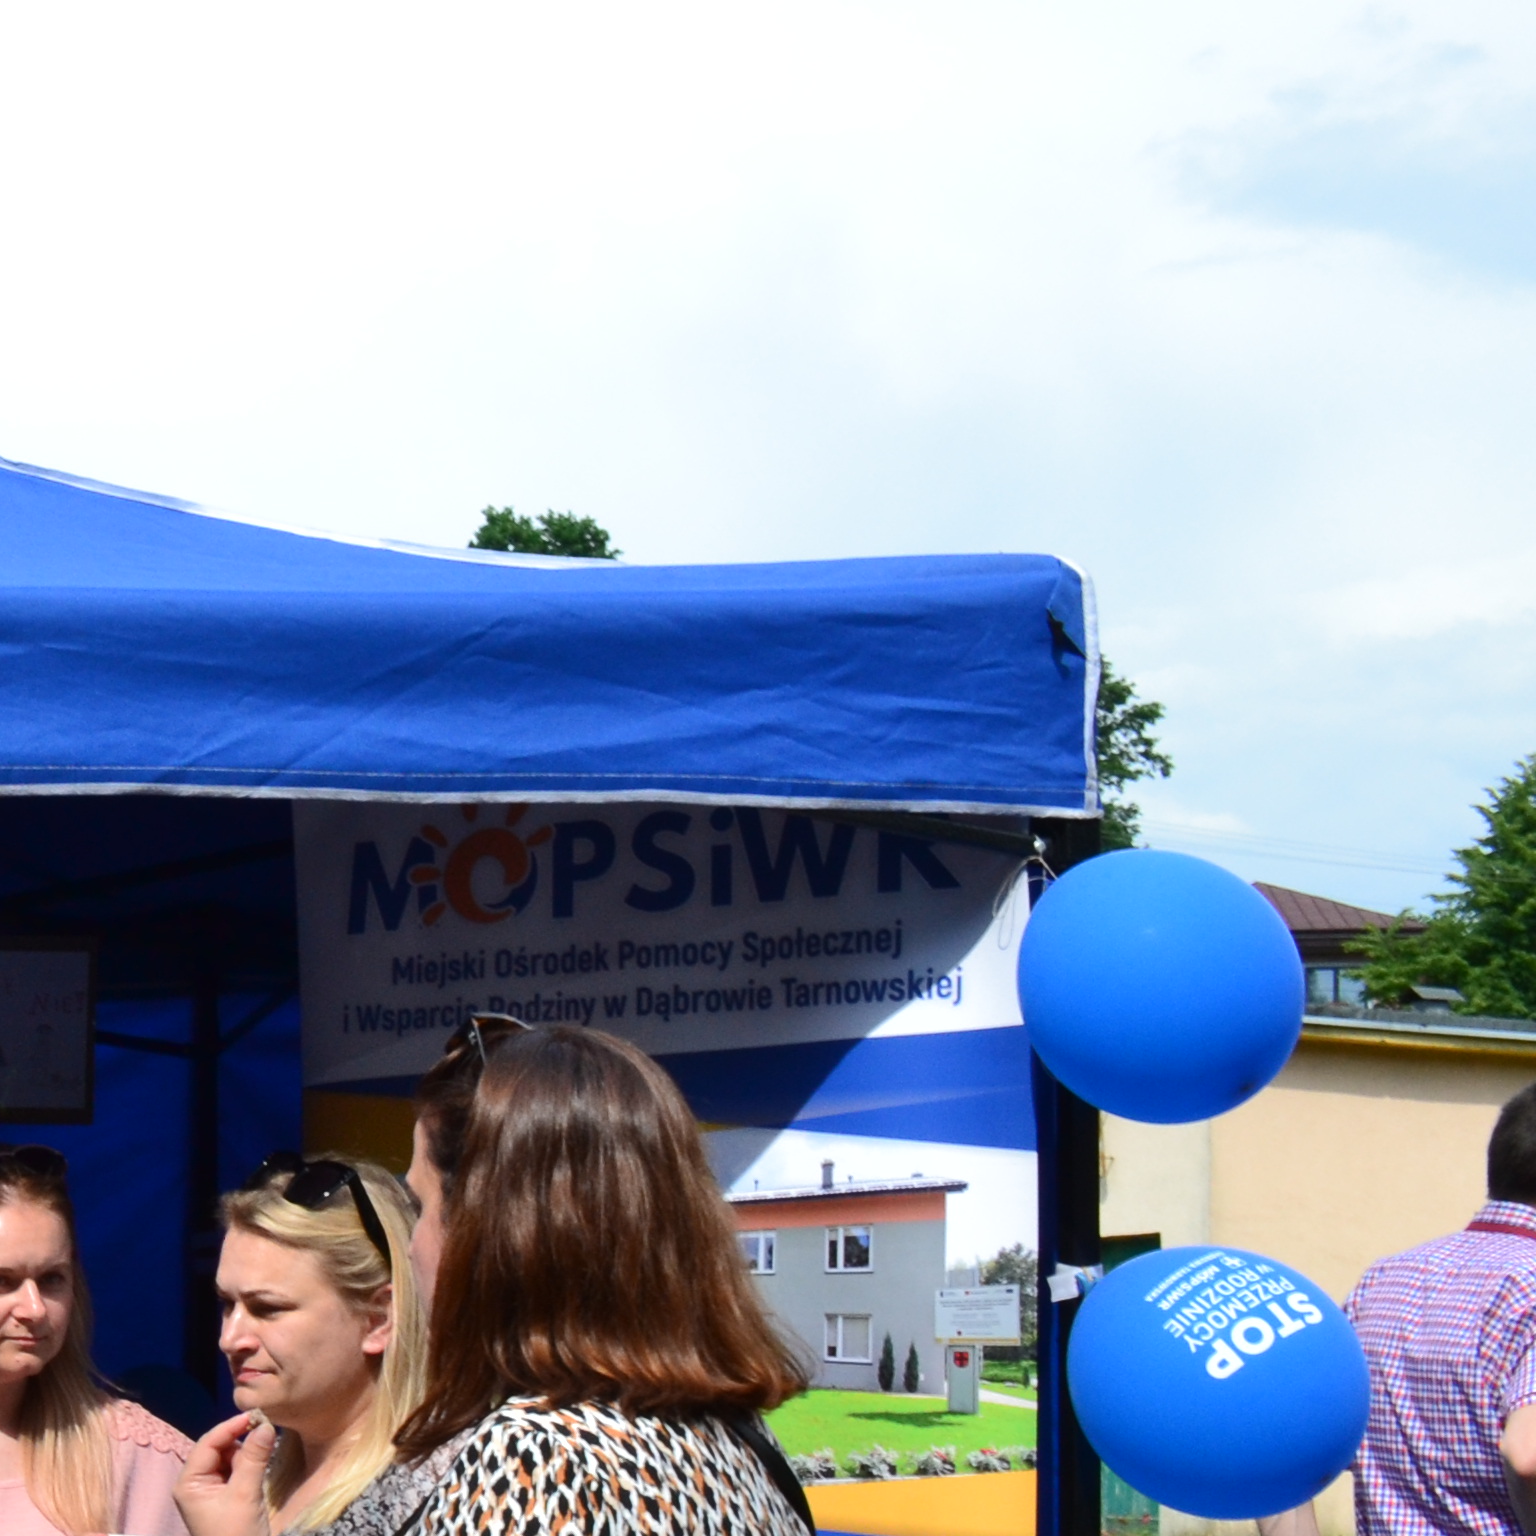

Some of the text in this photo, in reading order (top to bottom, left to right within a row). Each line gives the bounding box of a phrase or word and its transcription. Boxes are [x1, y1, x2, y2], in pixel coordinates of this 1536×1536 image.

[392, 919, 904, 988] Miejski Ośrodek Pomocy Społecznej
[603, 999, 627, 1018] w
[636, 979, 772, 1022] Dąbrowie
[781, 967, 963, 1006] Tarnowskiej
[1163, 1268, 1261, 1338] RODZINIE
[1183, 1276, 1296, 1354] PRZEMOCY
[1205, 1291, 1324, 1380] STOP
